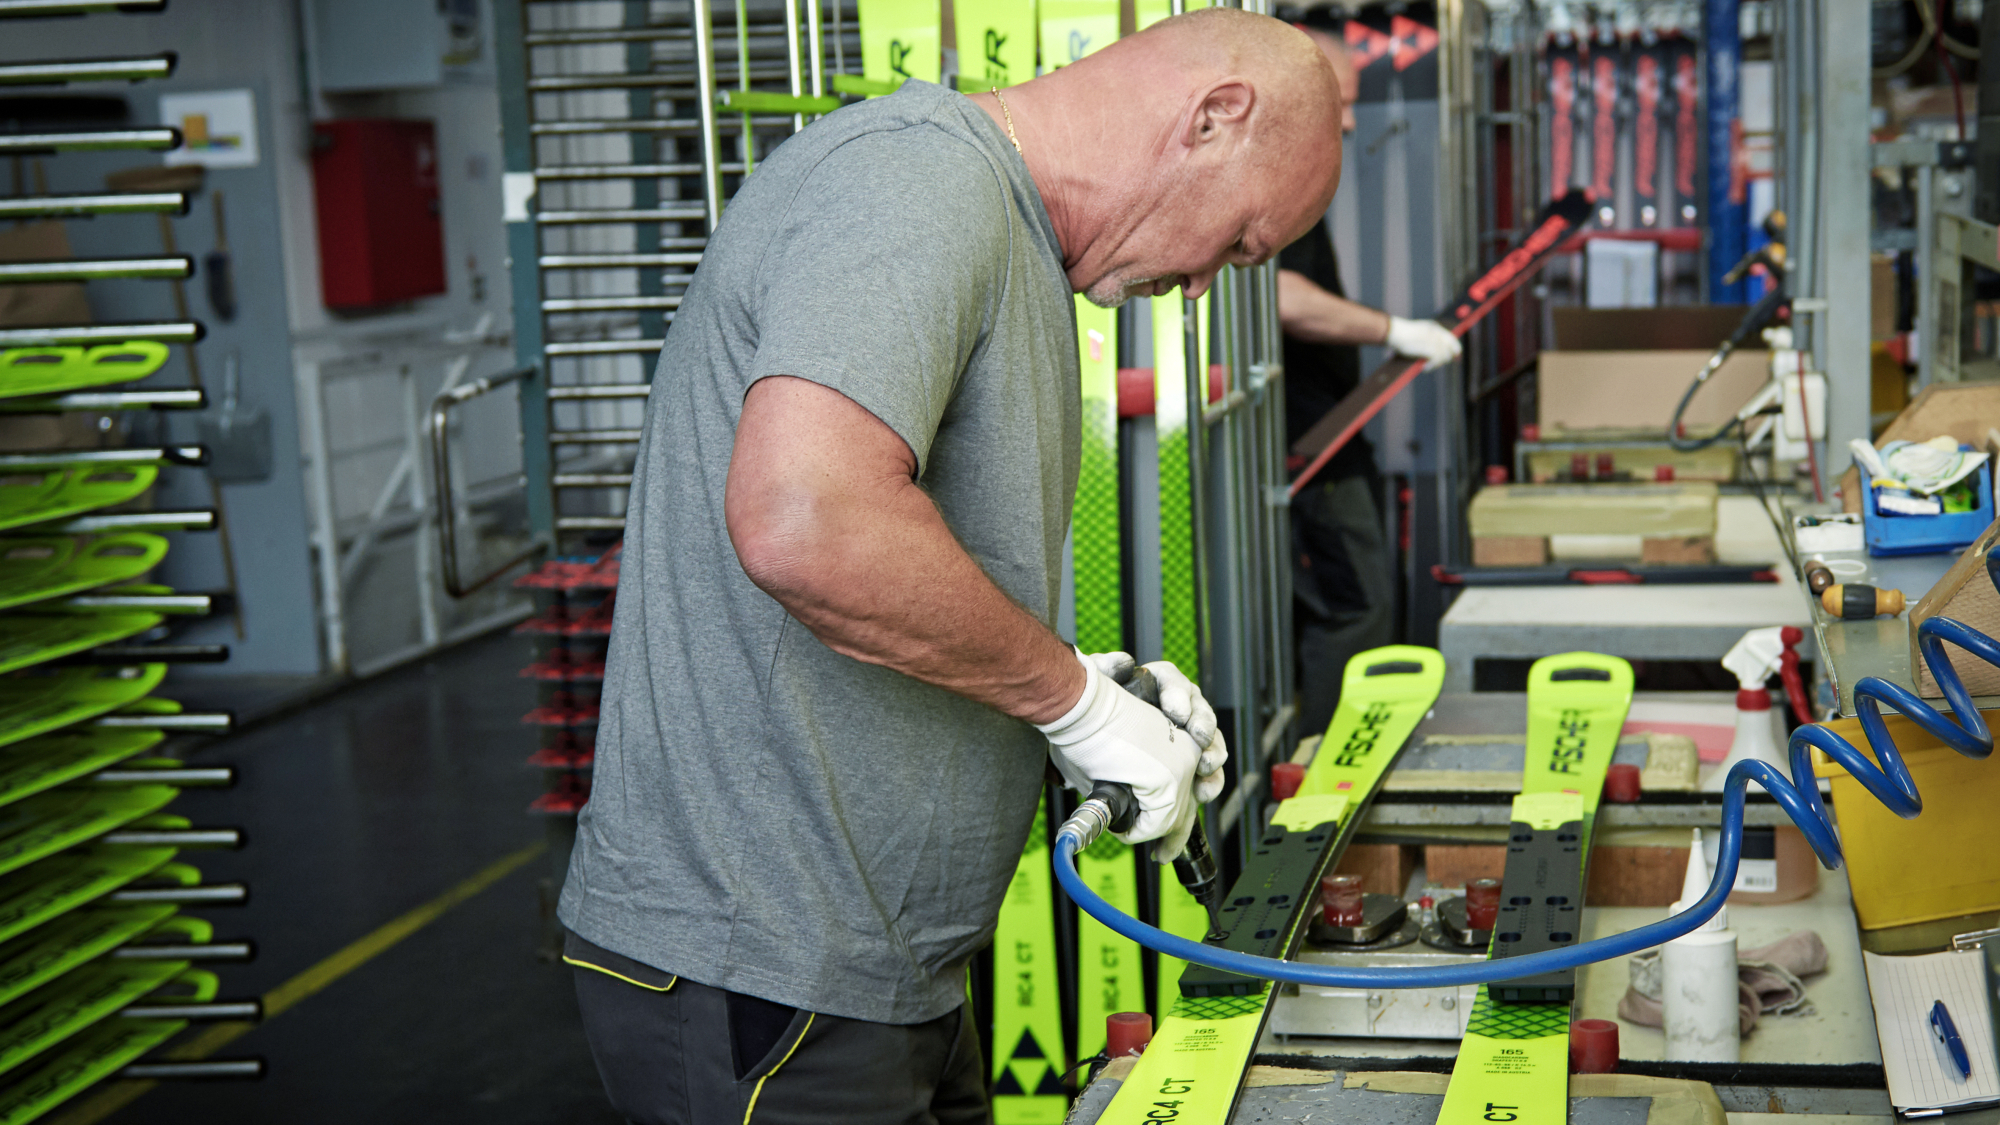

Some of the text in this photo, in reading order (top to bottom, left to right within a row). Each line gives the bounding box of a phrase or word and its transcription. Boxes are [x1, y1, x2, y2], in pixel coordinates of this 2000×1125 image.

[1333, 701, 1392, 768] FISCHER
[1549, 708, 1589, 776] FISCHER
[1159, 1078, 1195, 1094] CT
[1484, 1103, 1518, 1122] CT
